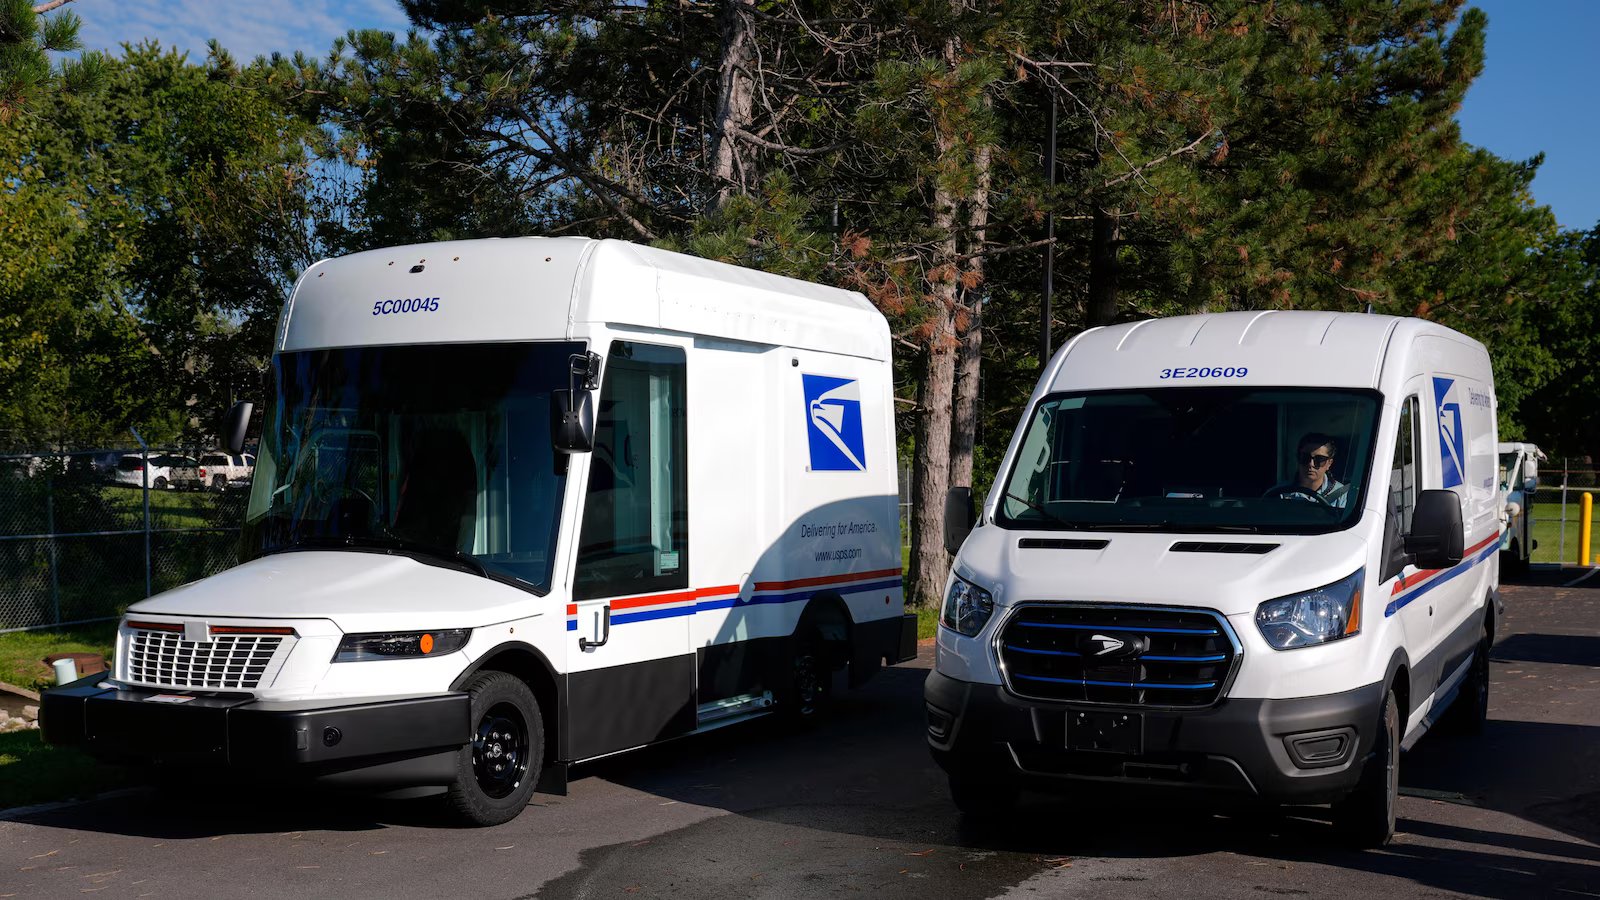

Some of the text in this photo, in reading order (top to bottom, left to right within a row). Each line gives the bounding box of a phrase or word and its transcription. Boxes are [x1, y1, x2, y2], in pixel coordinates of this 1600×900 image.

[372, 297, 440, 315] 5C00045
[1159, 367, 1248, 379] 3E20609
[801, 524, 836, 539] Delivering
[837, 523, 847, 535] for
[815, 548, 862, 562] www.usps.com
